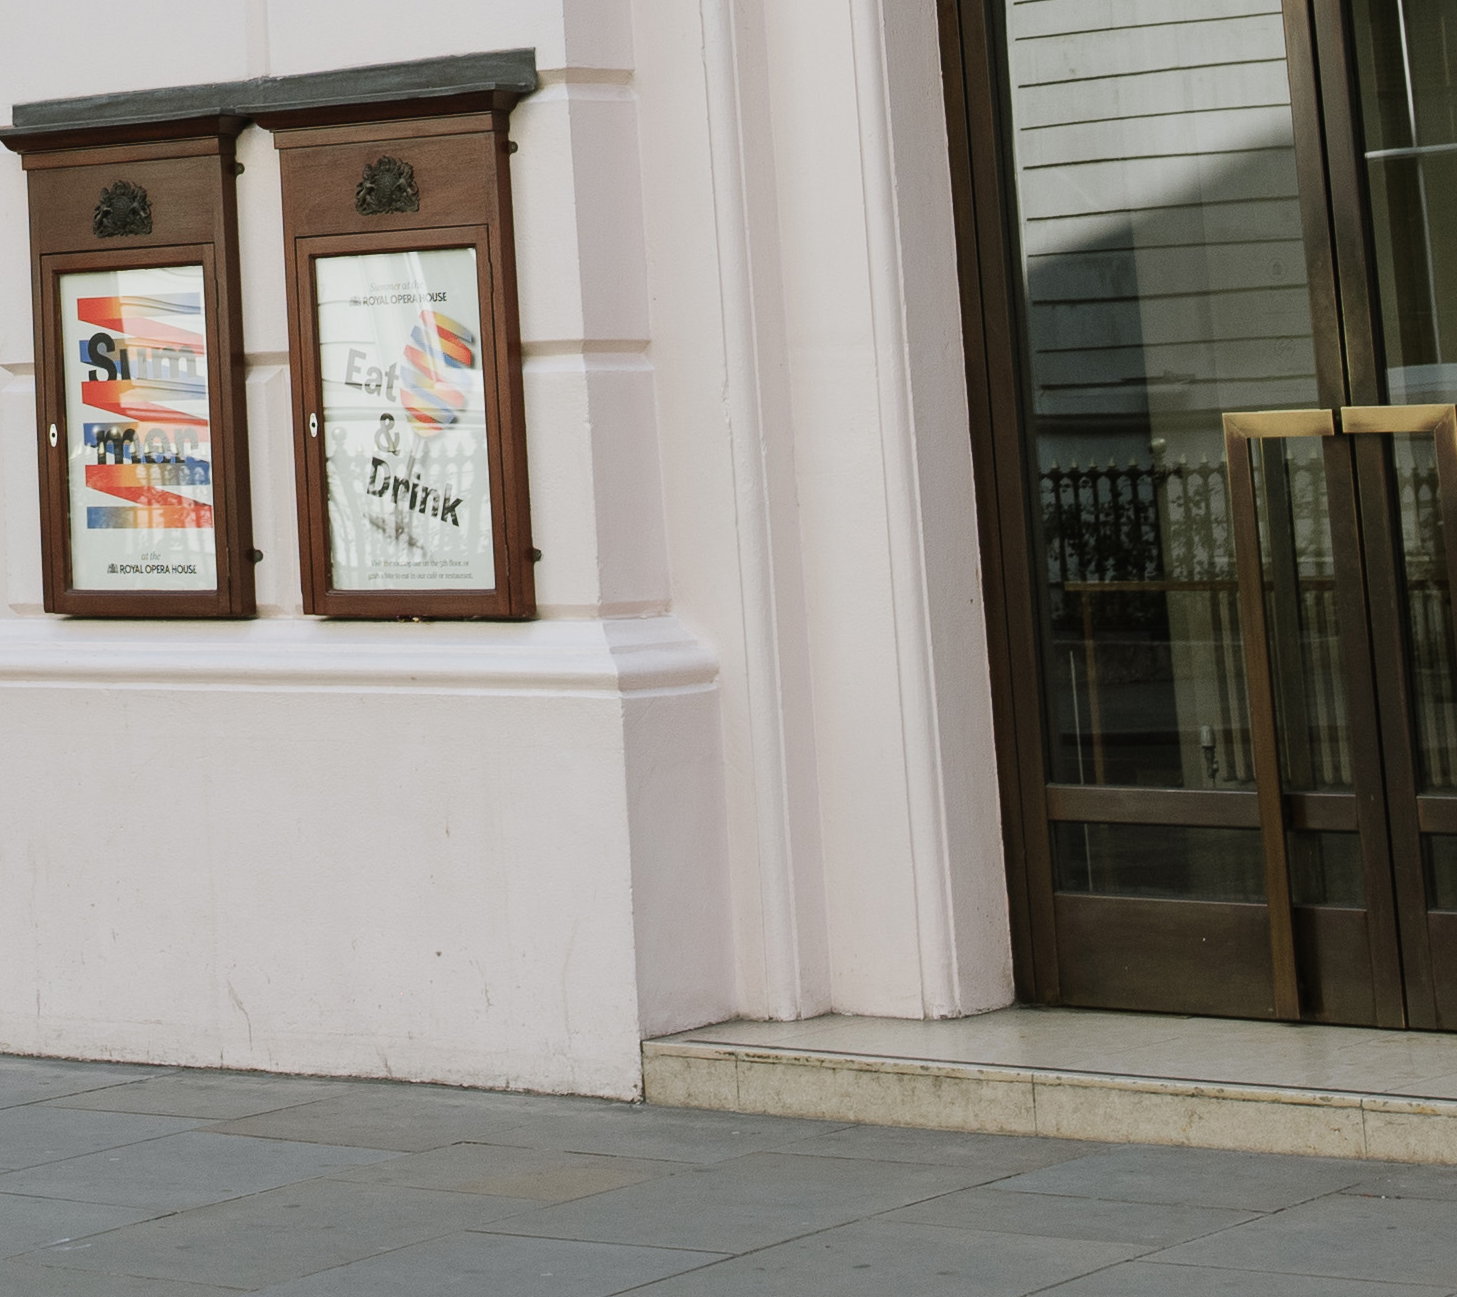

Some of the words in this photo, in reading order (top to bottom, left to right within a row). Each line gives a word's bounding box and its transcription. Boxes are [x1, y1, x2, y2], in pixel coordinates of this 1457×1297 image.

[363, 296, 389, 306] ROYAL
[390, 294, 418, 304] OPERA
[344, 348, 400, 403] Eat
[374, 413, 400, 456] &
[367, 457, 463, 526] Drink
[119, 564, 144, 575] ROYAL
[145, 564, 171, 574] OPERA
[172, 564, 197, 574] HOUSE
